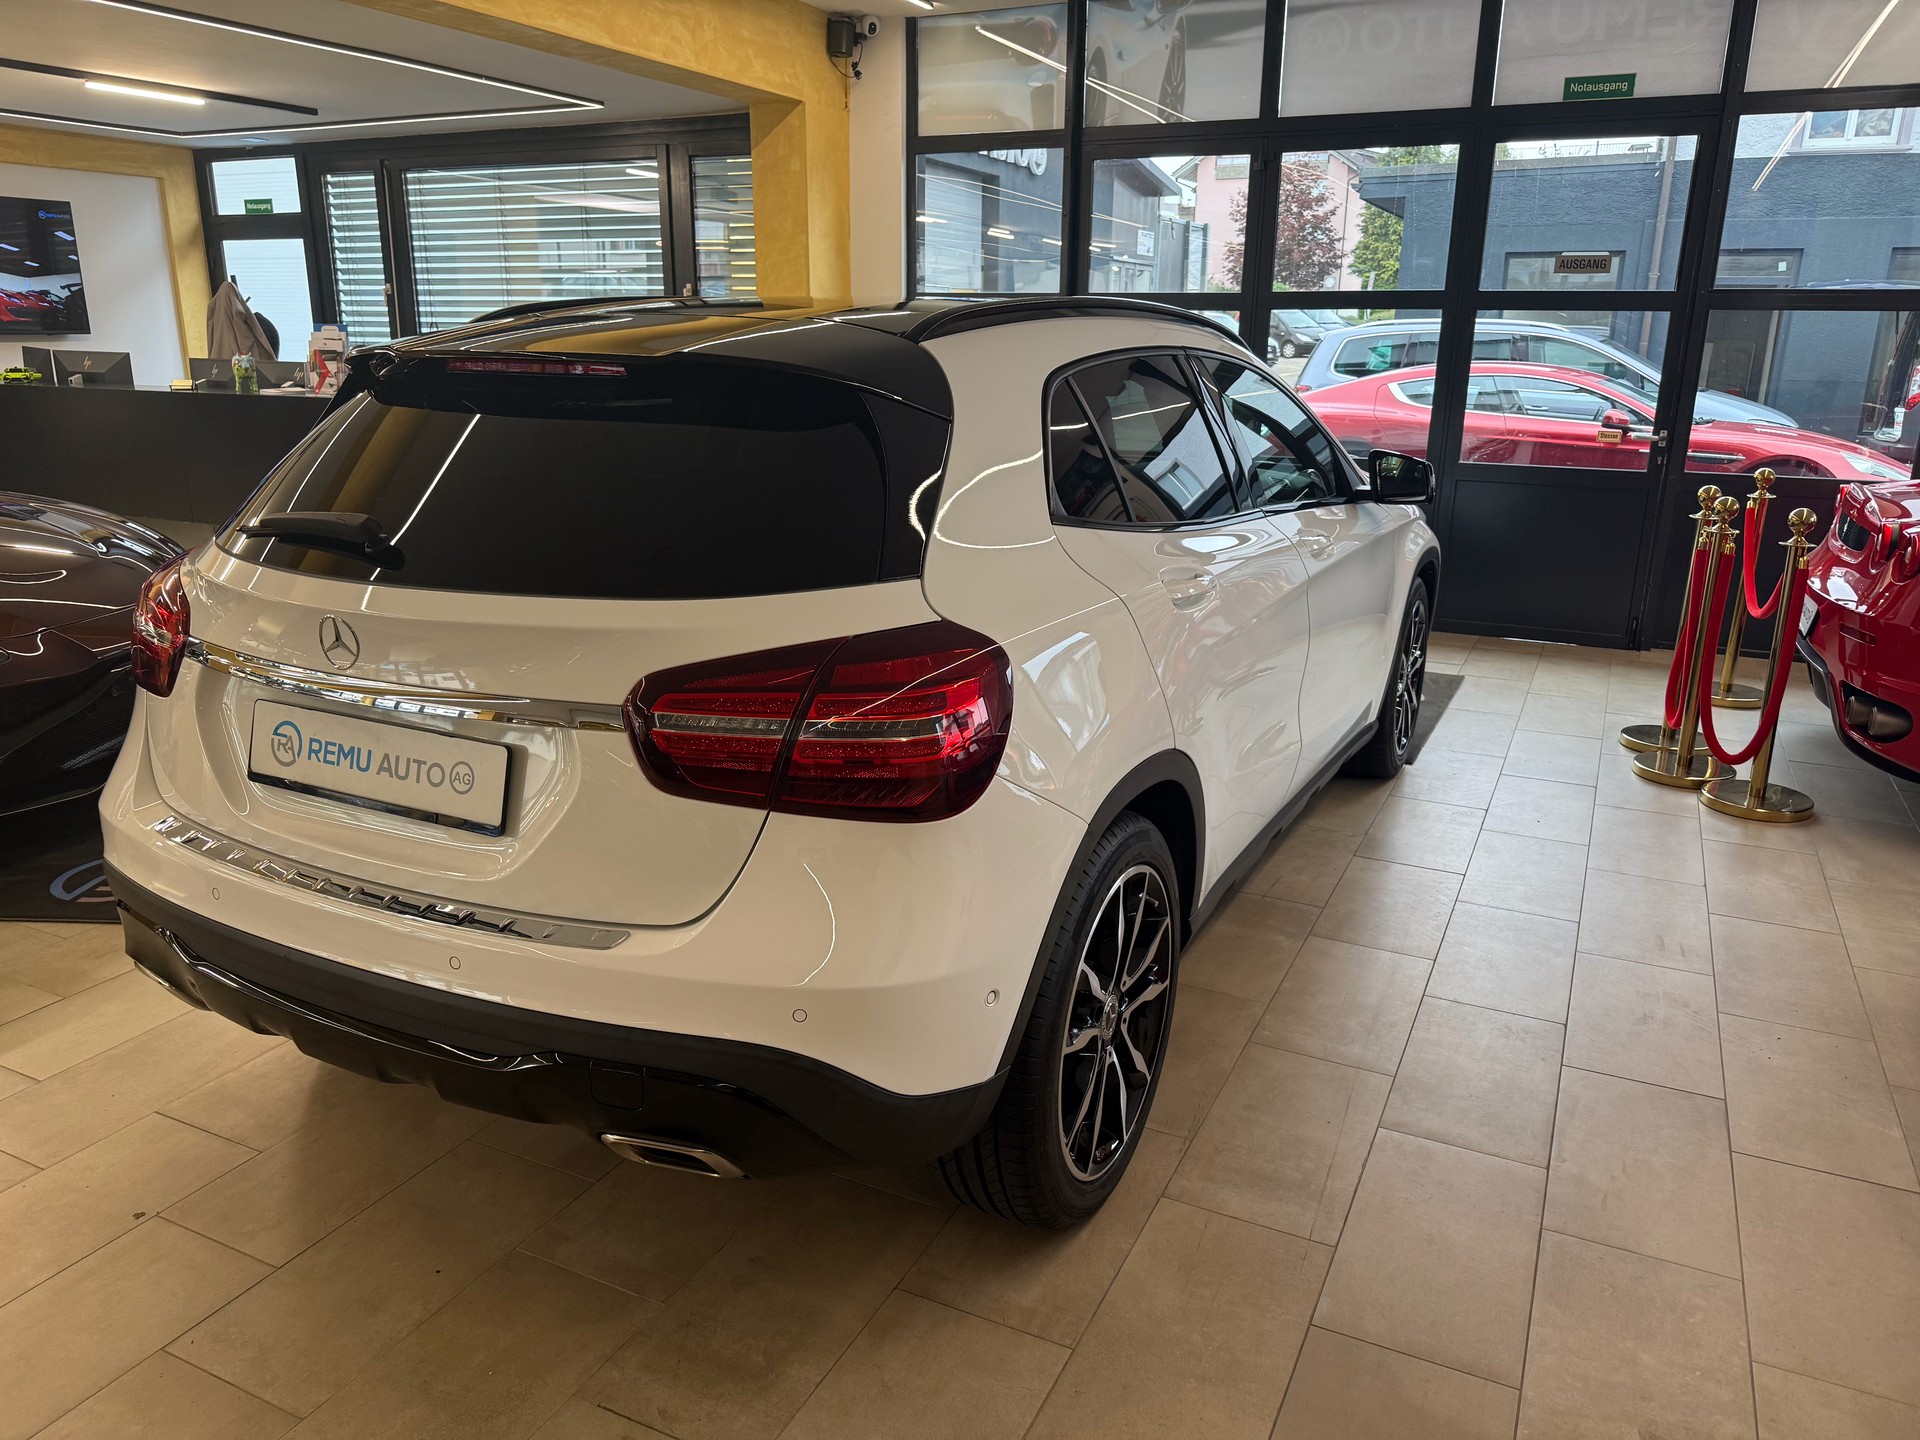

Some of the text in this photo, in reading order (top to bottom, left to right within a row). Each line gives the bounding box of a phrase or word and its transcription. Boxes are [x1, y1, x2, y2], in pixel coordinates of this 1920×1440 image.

[1570, 81, 1628, 93] Notausgang
[246, 202, 271, 211] Notausgang
[1559, 258, 1607, 270] AUSGANG
[307, 737, 372, 773] REMU
[375, 752, 446, 788] AUTO
[452, 771, 471, 786] AG
